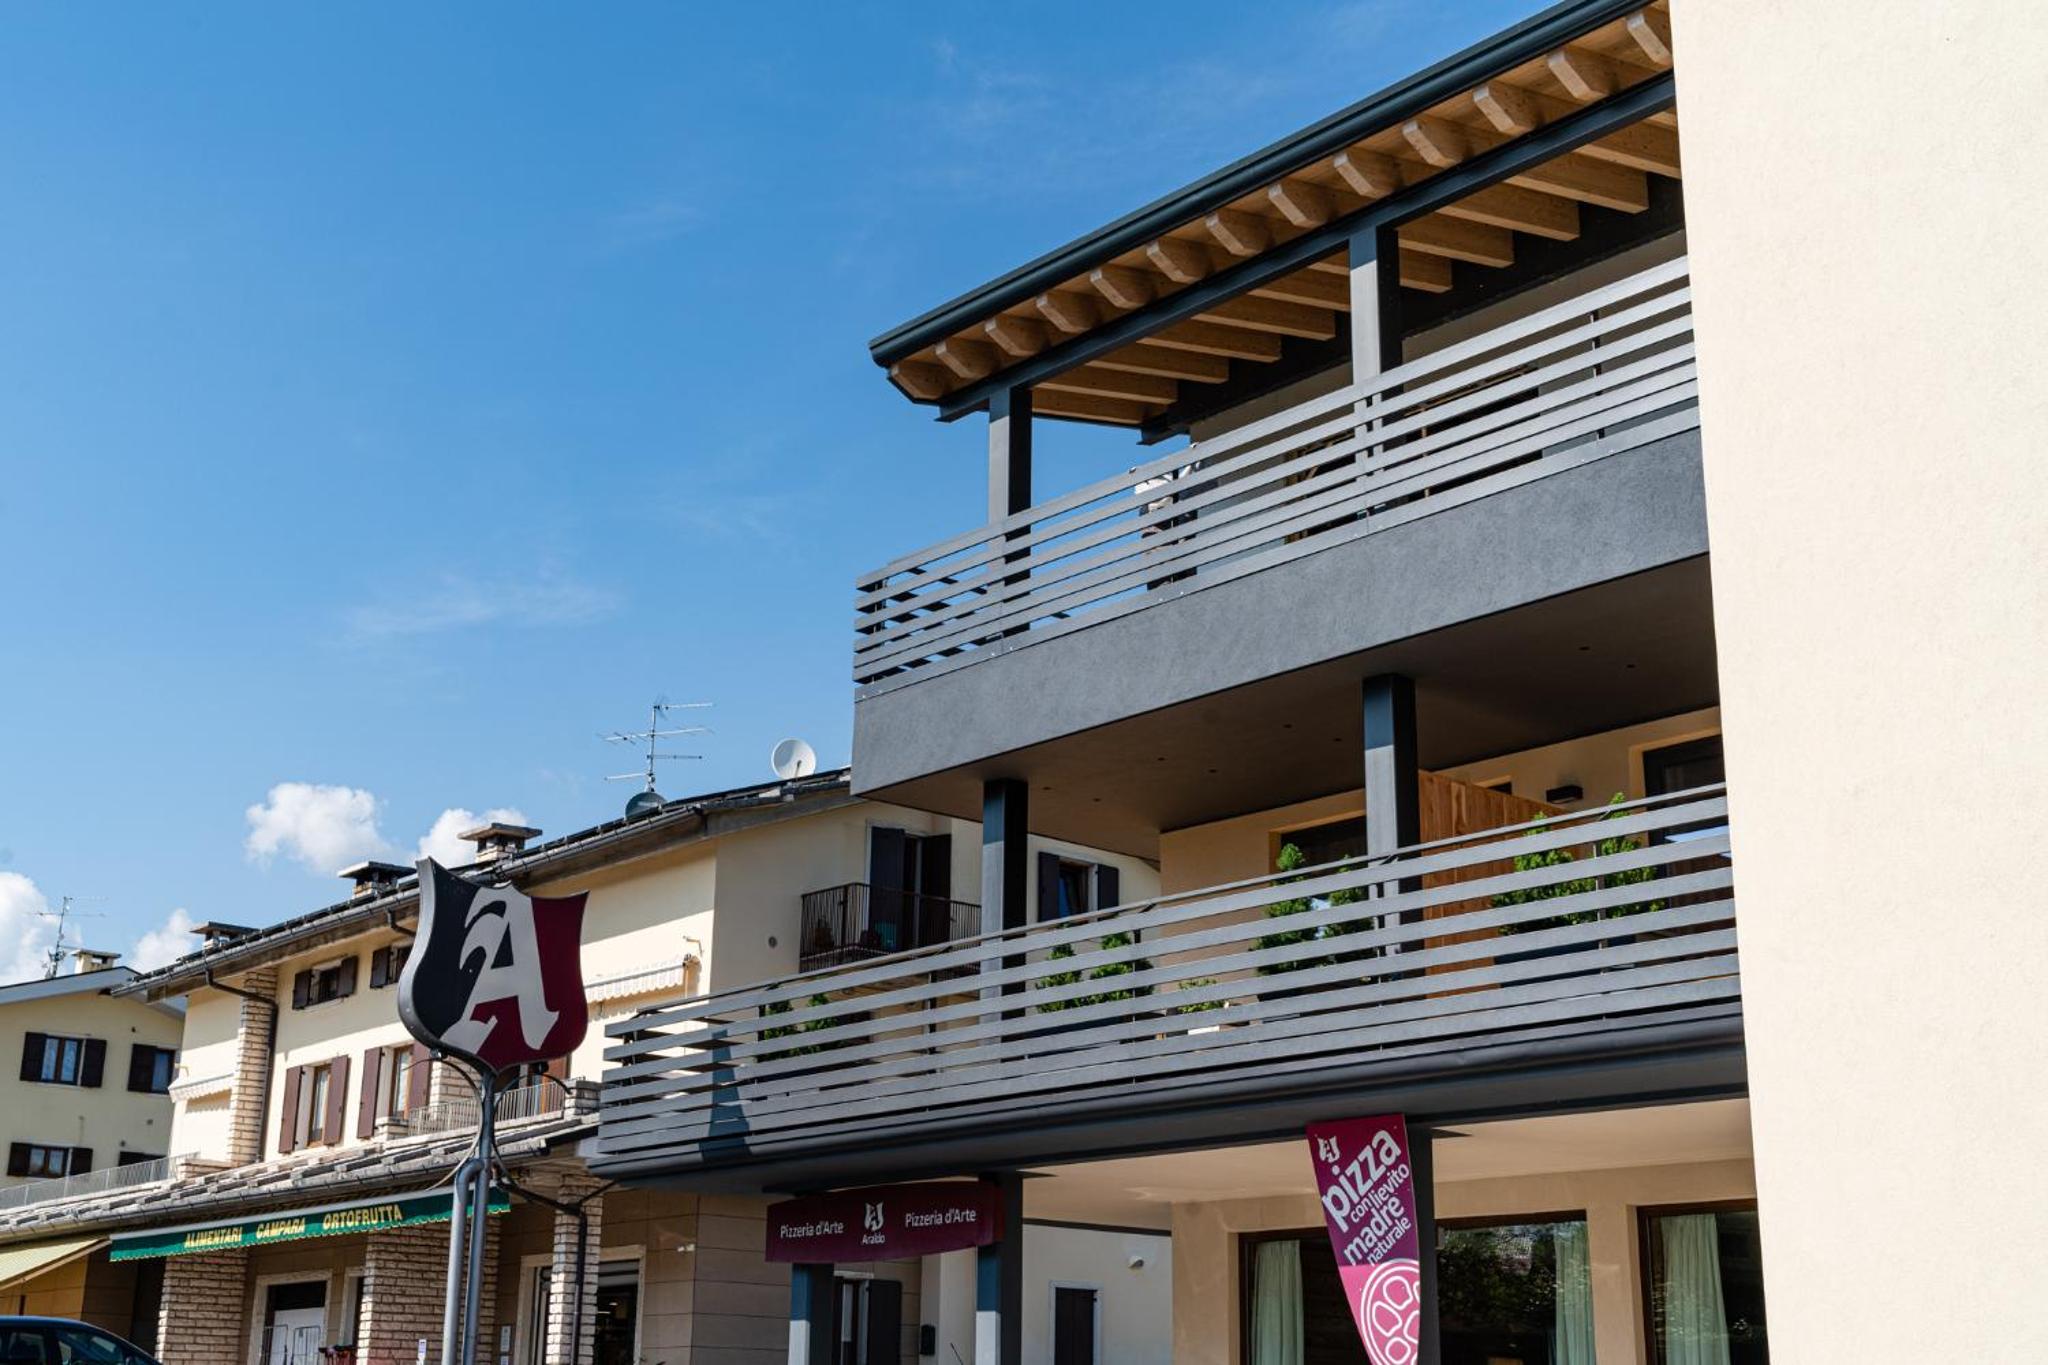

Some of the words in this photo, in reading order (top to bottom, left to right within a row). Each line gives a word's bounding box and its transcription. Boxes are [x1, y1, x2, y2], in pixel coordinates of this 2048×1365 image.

[439, 882, 560, 1055] A
[1321, 1130, 1401, 1233] pizza
[1350, 1197, 1372, 1223] con
[1371, 1163, 1410, 1208] lievito
[184, 1226, 243, 1248] ALIMENTARI
[322, 1204, 403, 1230] ORTOFRUTTA
[780, 1225, 814, 1239] Pizzeria
[815, 1220, 844, 1236] d'Arte
[862, 1233, 885, 1245] Araldo
[905, 1211, 943, 1227] Pizzeria
[944, 1208, 977, 1224] d'Arte
[1343, 1196, 1404, 1266] madre
[1366, 1216, 1411, 1266] naturale
